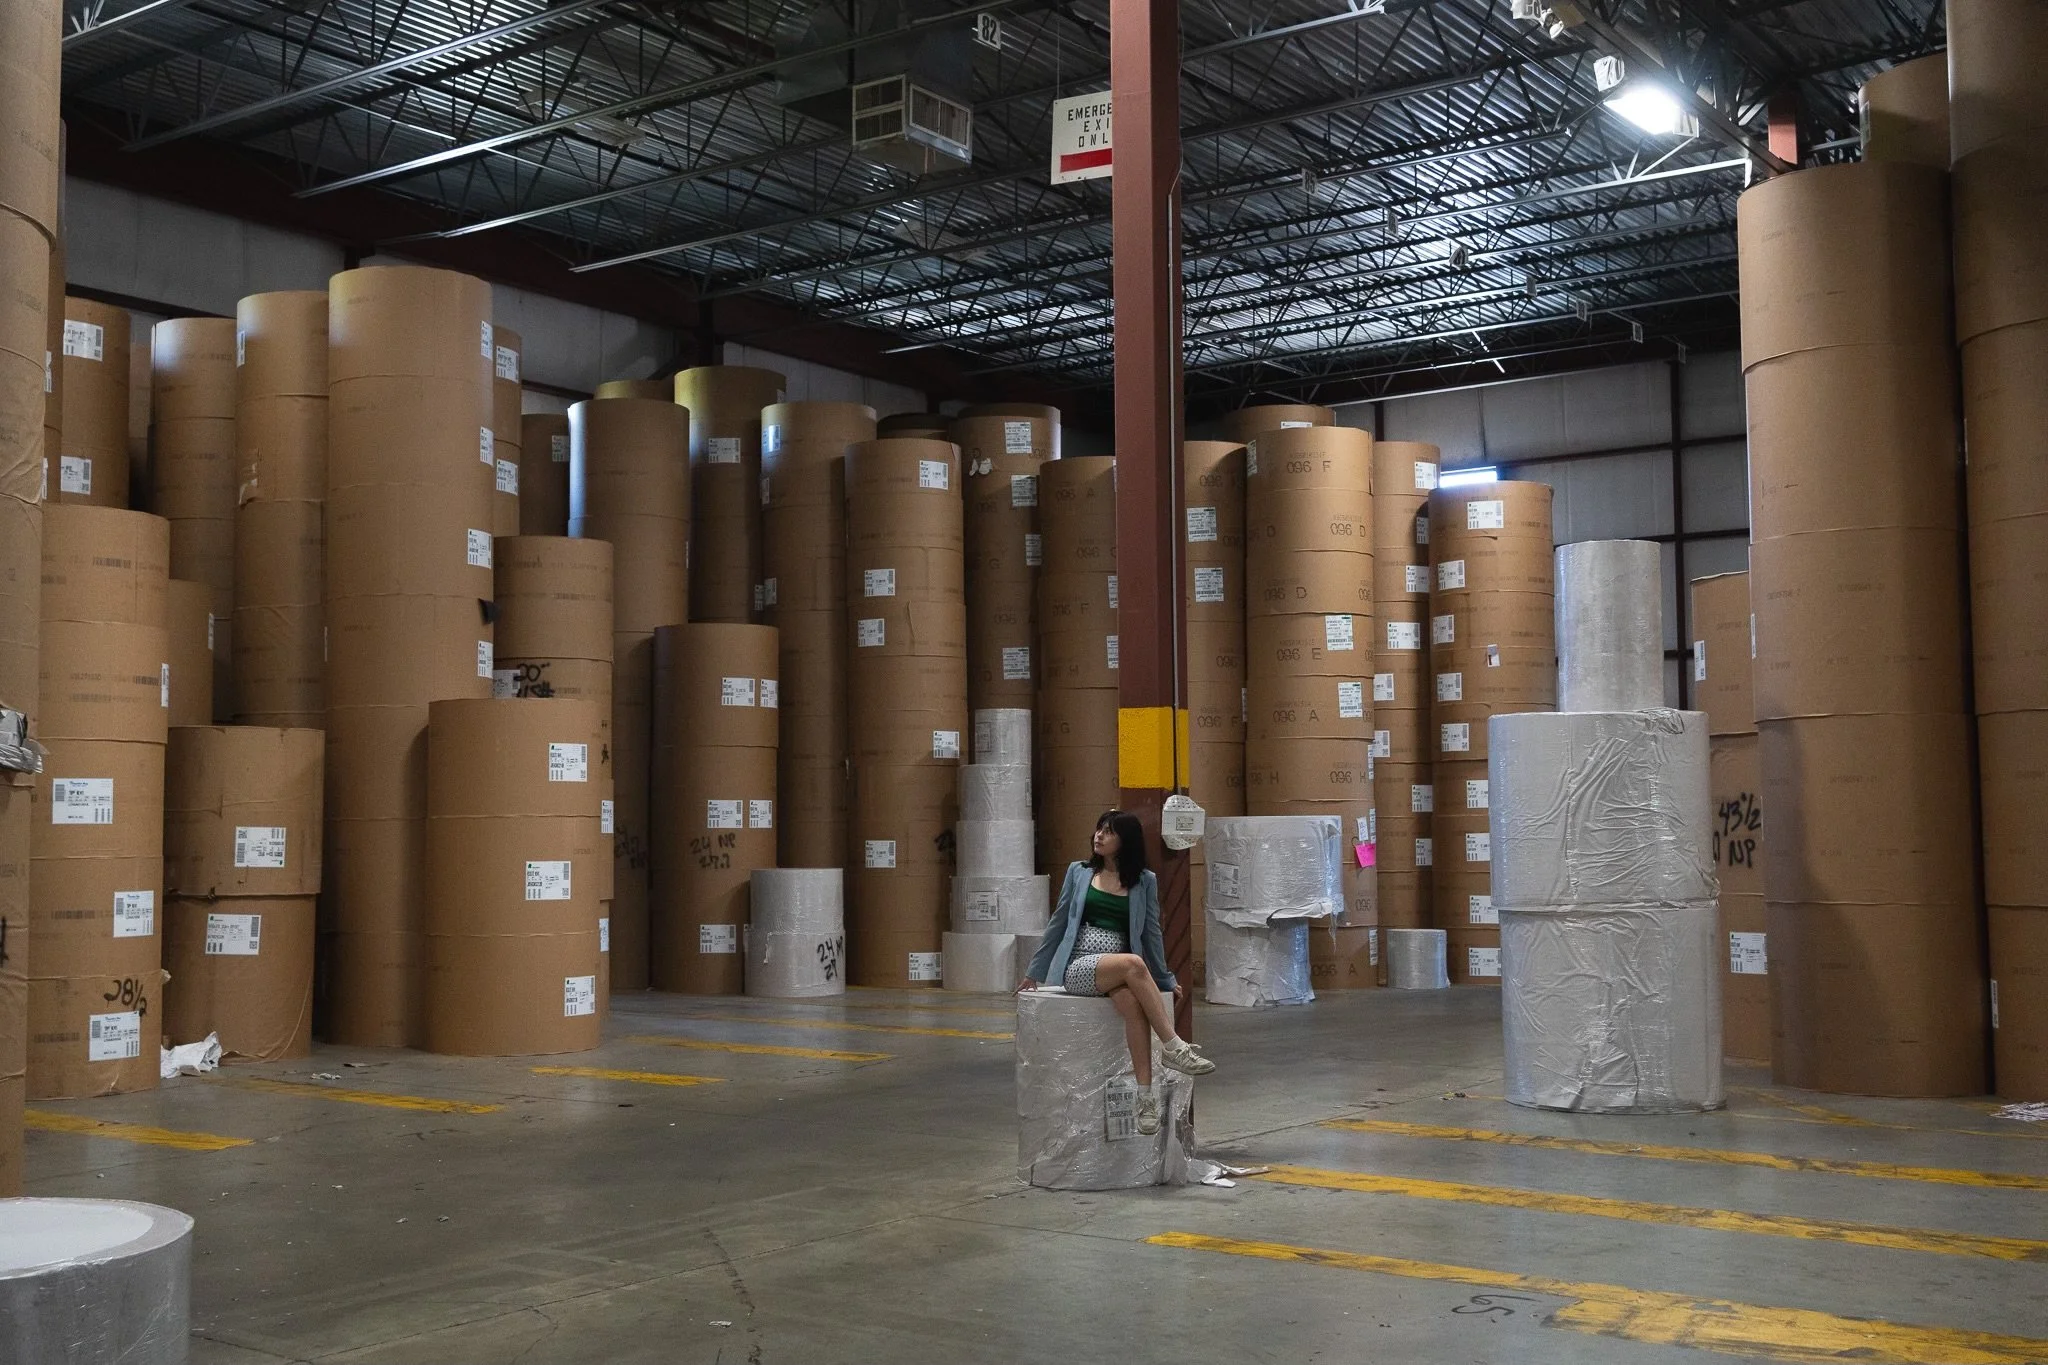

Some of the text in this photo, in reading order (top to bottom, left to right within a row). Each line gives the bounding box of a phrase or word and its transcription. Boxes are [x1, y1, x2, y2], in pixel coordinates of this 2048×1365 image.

[981, 15, 997, 45] 82
[1286, 460, 1332, 474] 096 F
[1329, 522, 1353, 536] 096
[1296, 586, 1308, 599] D
[1272, 709, 1320, 723] 096 A
[1329, 770, 1353, 784] 096
